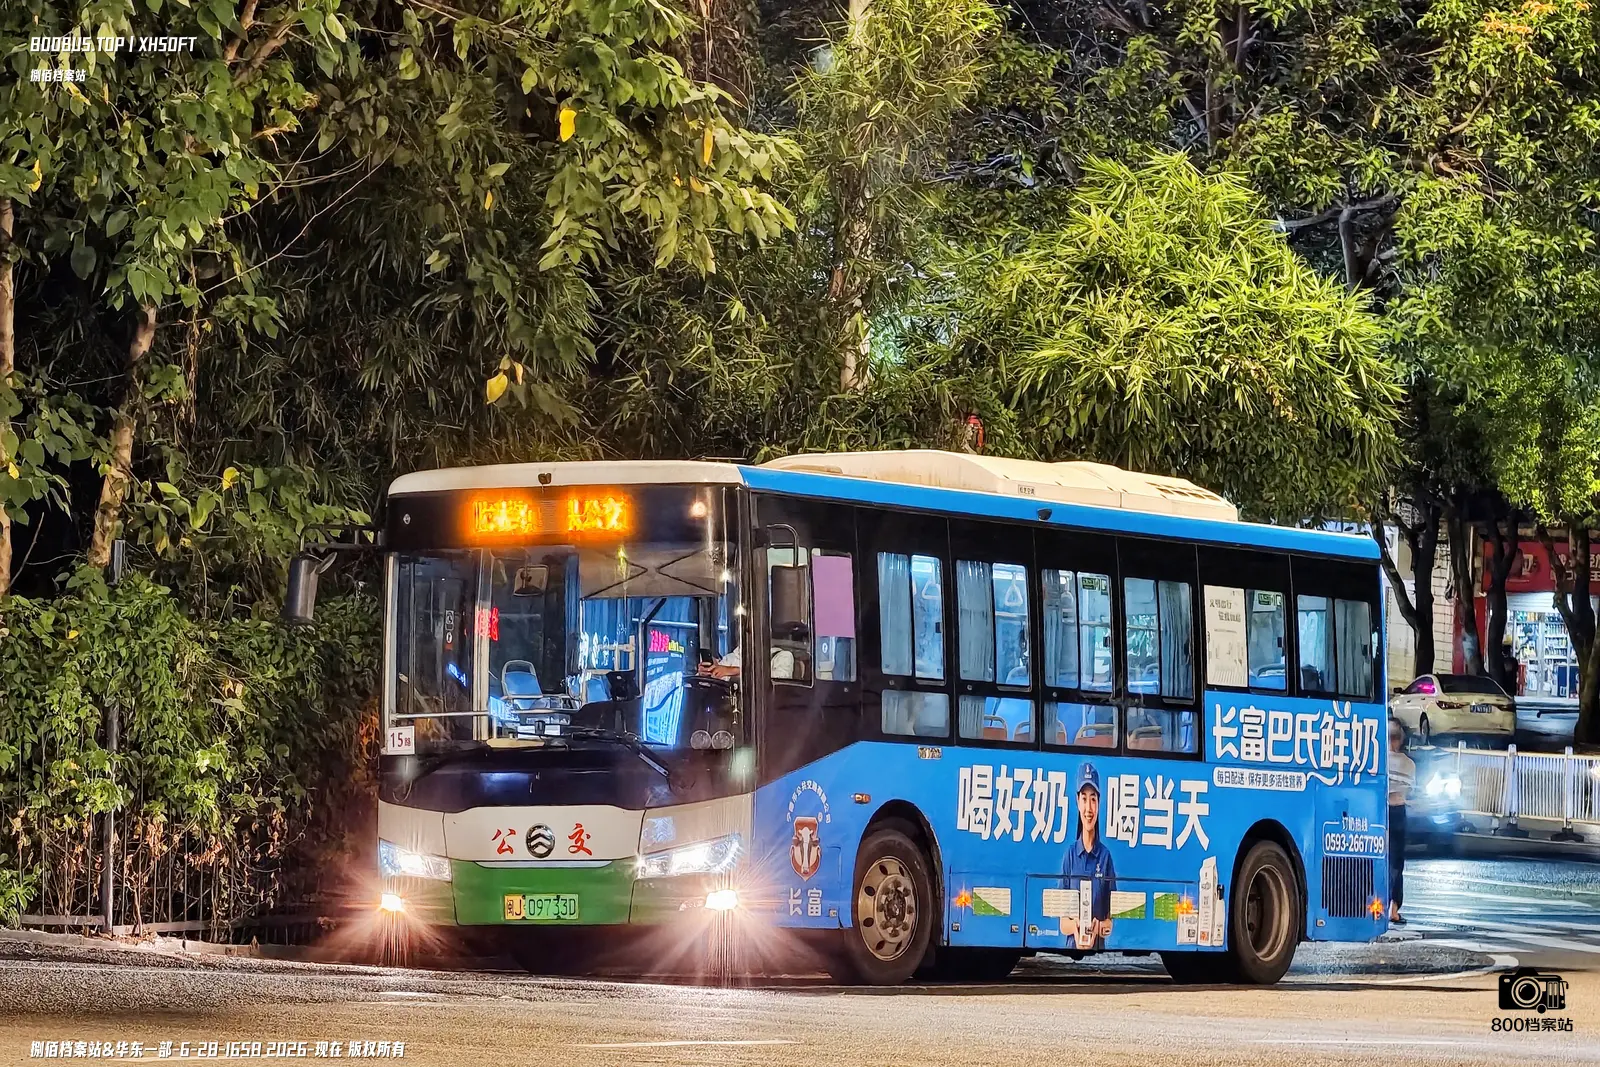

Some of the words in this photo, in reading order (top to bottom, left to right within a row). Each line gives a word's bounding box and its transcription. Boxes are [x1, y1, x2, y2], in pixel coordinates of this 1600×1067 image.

[1212, 700, 1380, 786] 长富巴氏鲜奶
[956, 764, 1069, 844] 喝好奶
[1105, 773, 1210, 851] 喝当天
[1325, 832, 1385, 854] 0593-2667799
[788, 887, 823, 917] 长富
